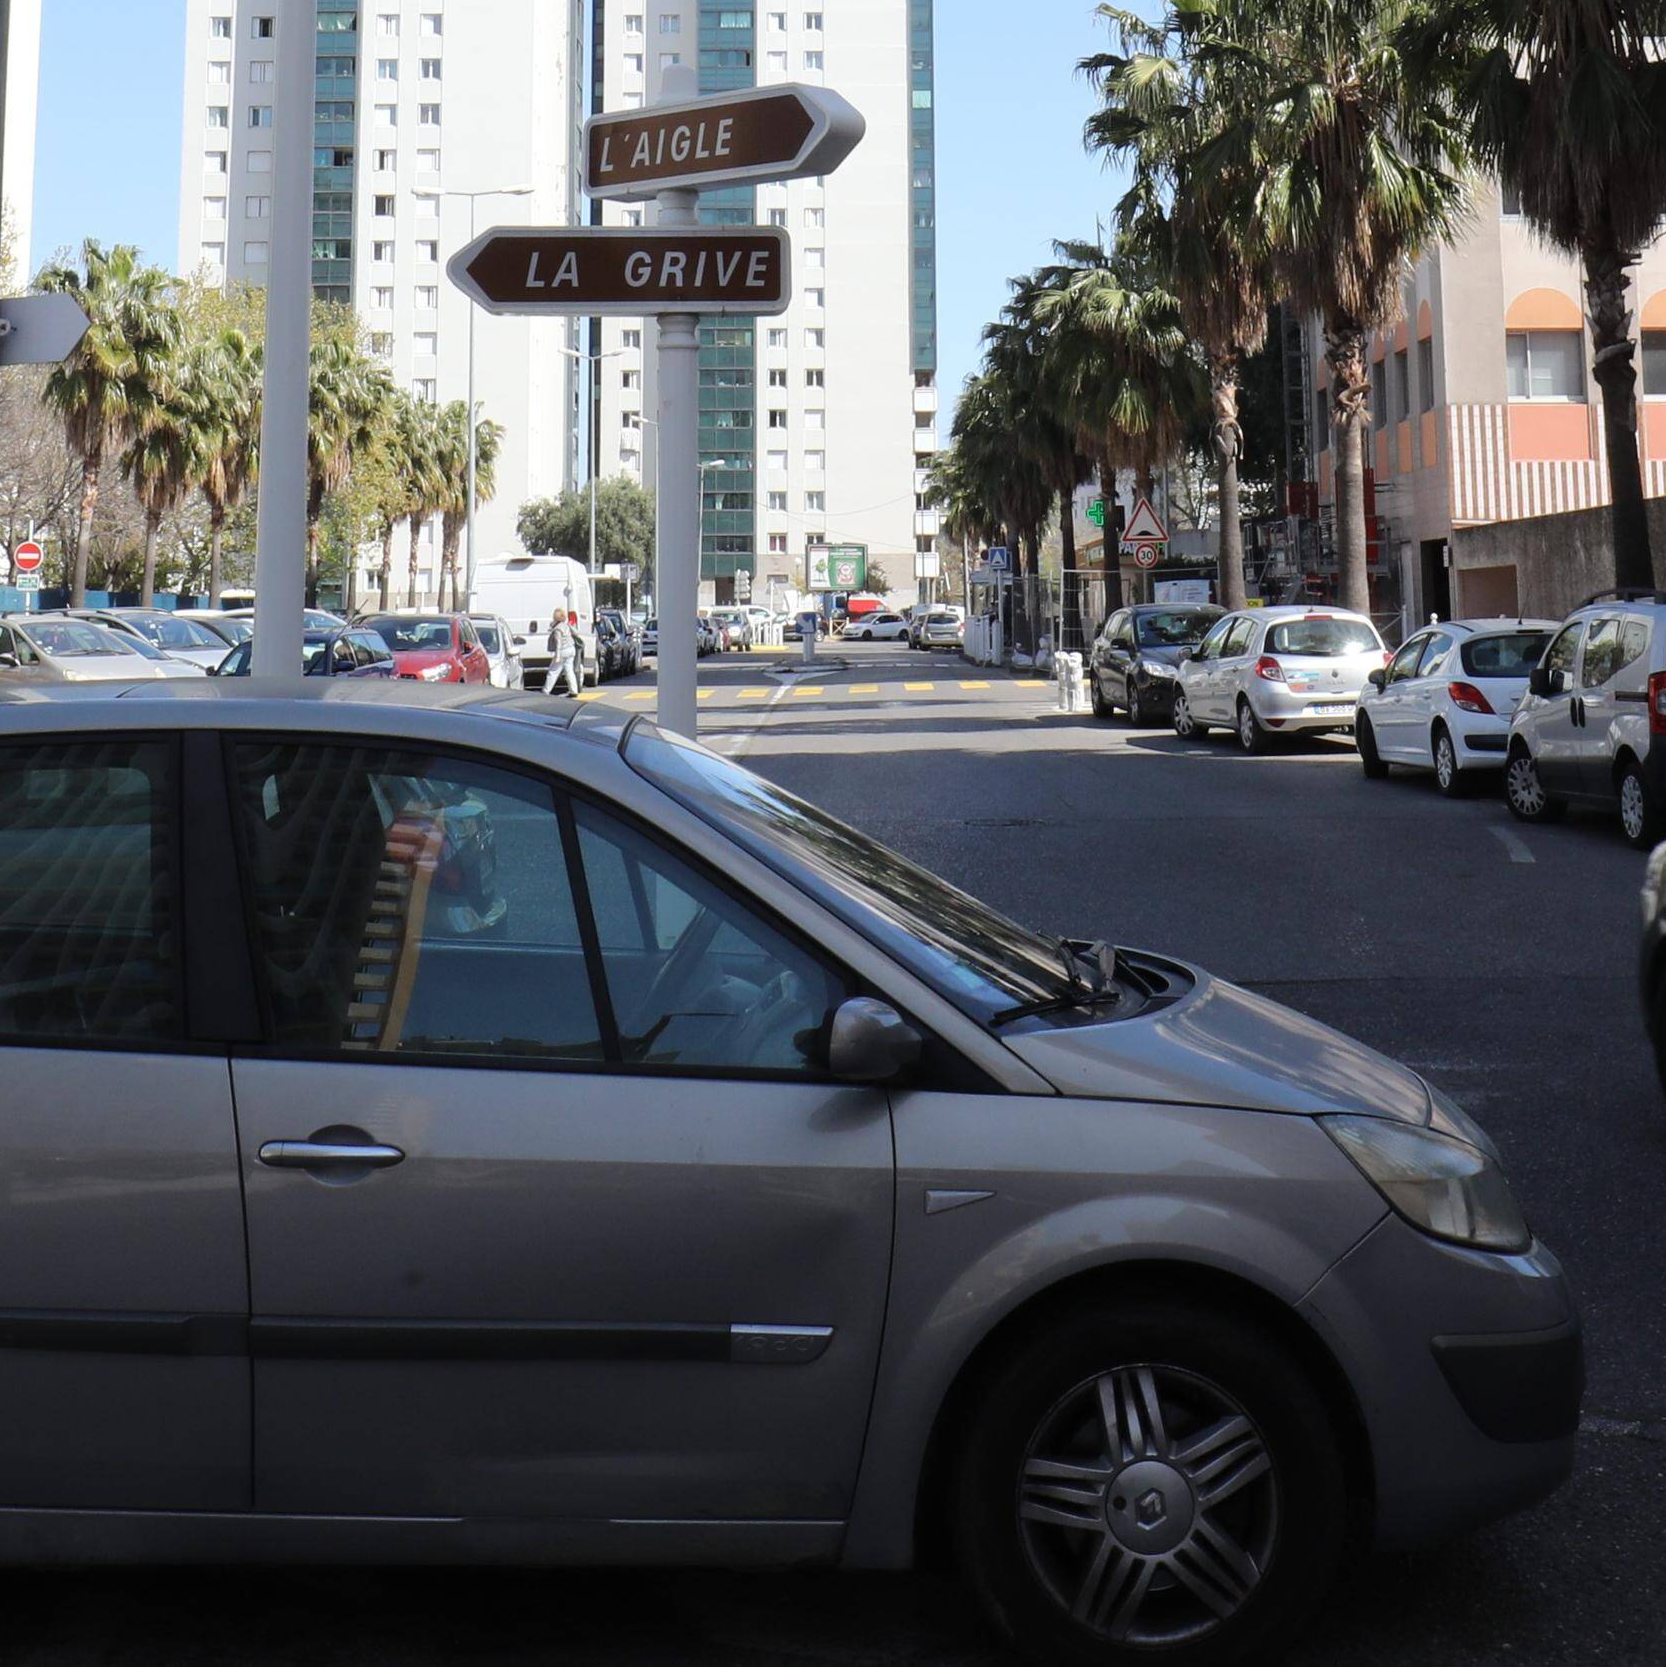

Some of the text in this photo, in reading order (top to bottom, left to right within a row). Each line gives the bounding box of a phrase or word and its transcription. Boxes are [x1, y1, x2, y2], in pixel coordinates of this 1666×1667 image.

[599, 117, 734, 172] L'AIGLE
[525, 250, 770, 288] LA GRIVE
[1141, 550, 1153, 560] 30
